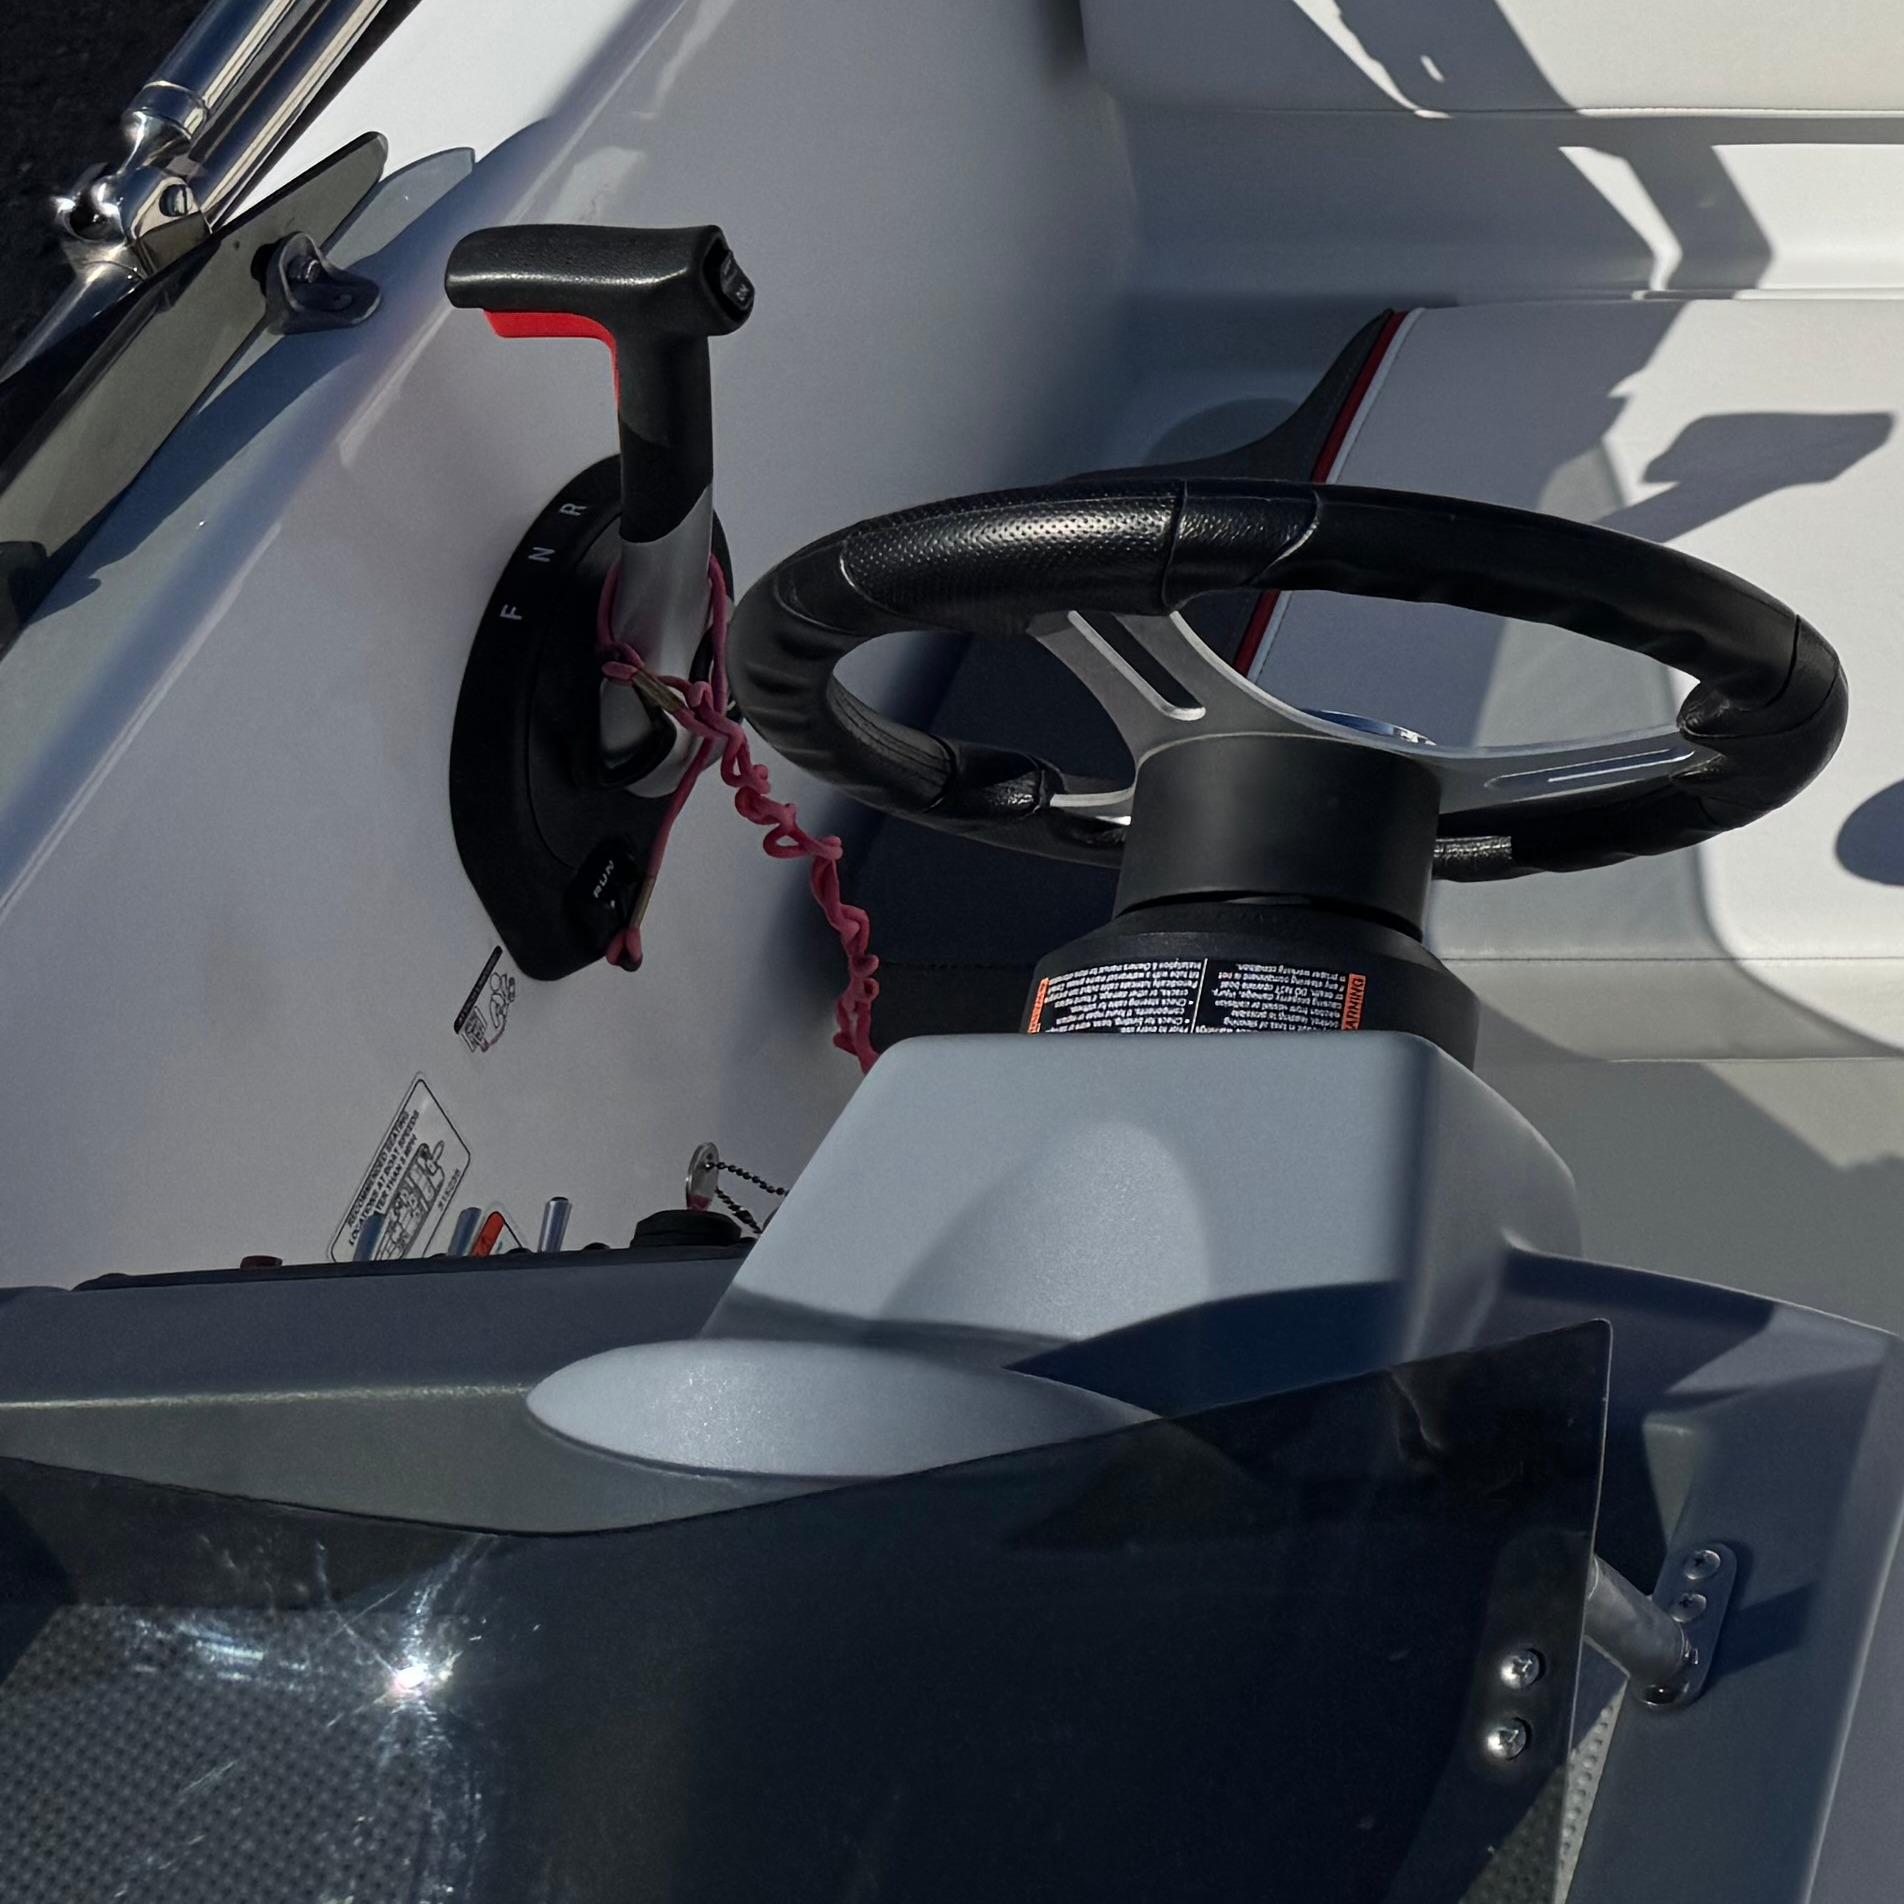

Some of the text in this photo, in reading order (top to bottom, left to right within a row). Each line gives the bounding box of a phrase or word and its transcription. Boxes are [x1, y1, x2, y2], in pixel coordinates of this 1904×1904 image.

[559, 503, 587, 516] R
[528, 547, 556, 562] N
[500, 604, 522, 621] F
[593, 859, 615, 899] RUN
[1344, 976, 1363, 1030] ARNING
